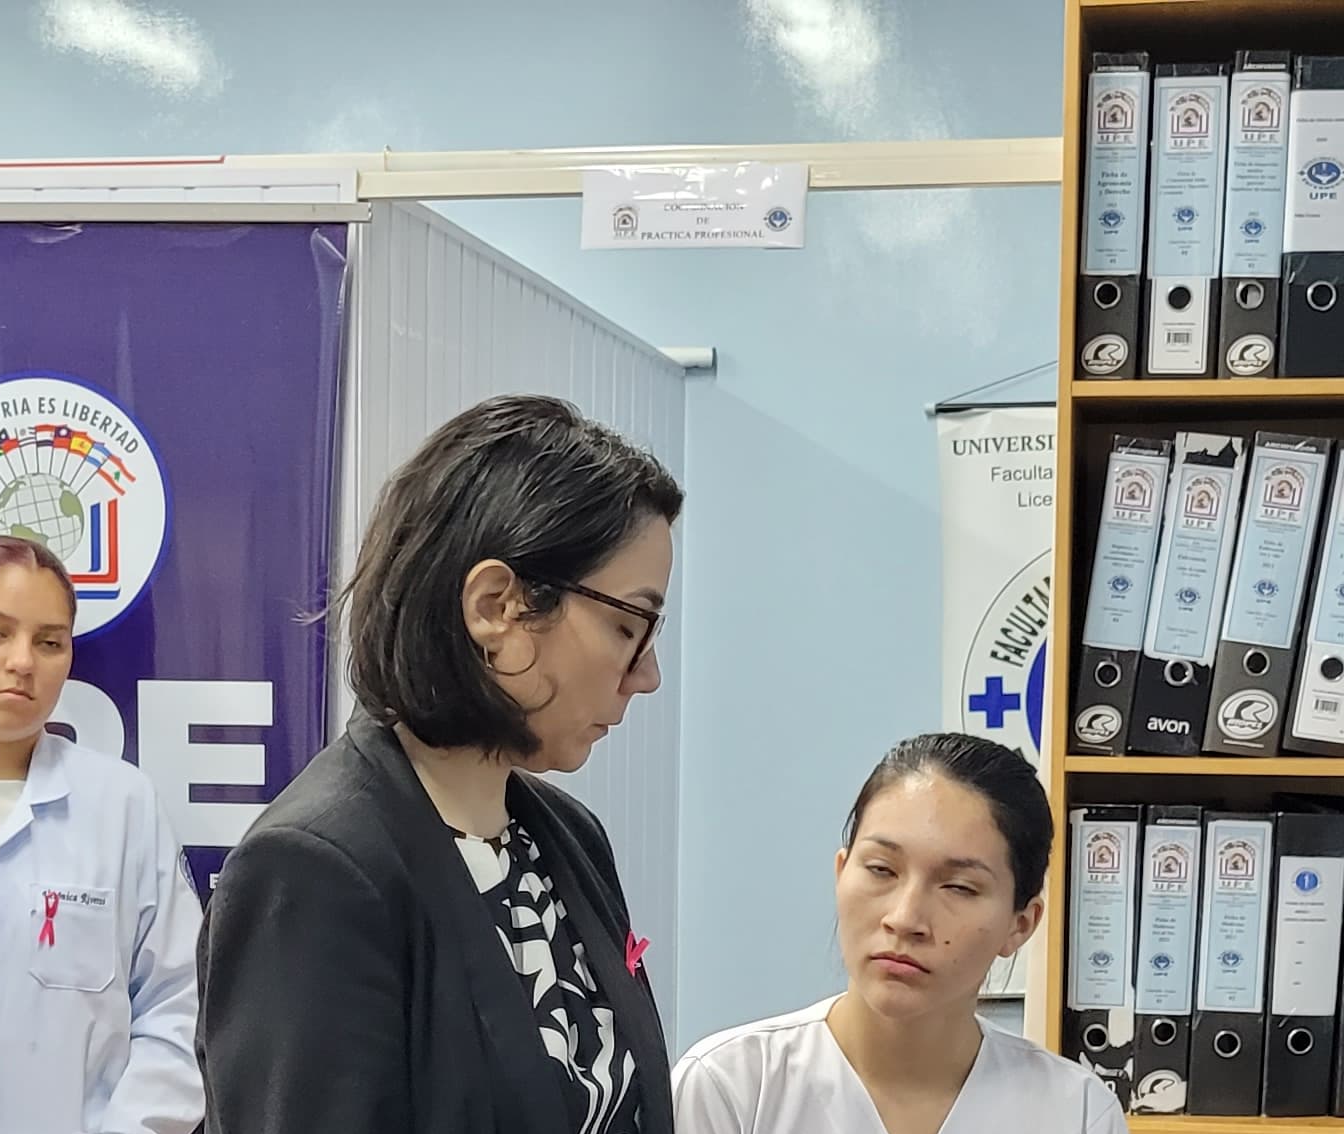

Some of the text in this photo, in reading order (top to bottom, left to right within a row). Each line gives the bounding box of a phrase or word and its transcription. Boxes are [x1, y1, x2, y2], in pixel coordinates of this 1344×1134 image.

[1309, 192, 1337, 200] UPE
[696, 217, 709, 226] DE
[38, 397, 56, 415] ES
[62, 398, 140, 455] LIBERTAD
[1017, 492, 1053, 508] Lice
[1147, 716, 1190, 735] avon
